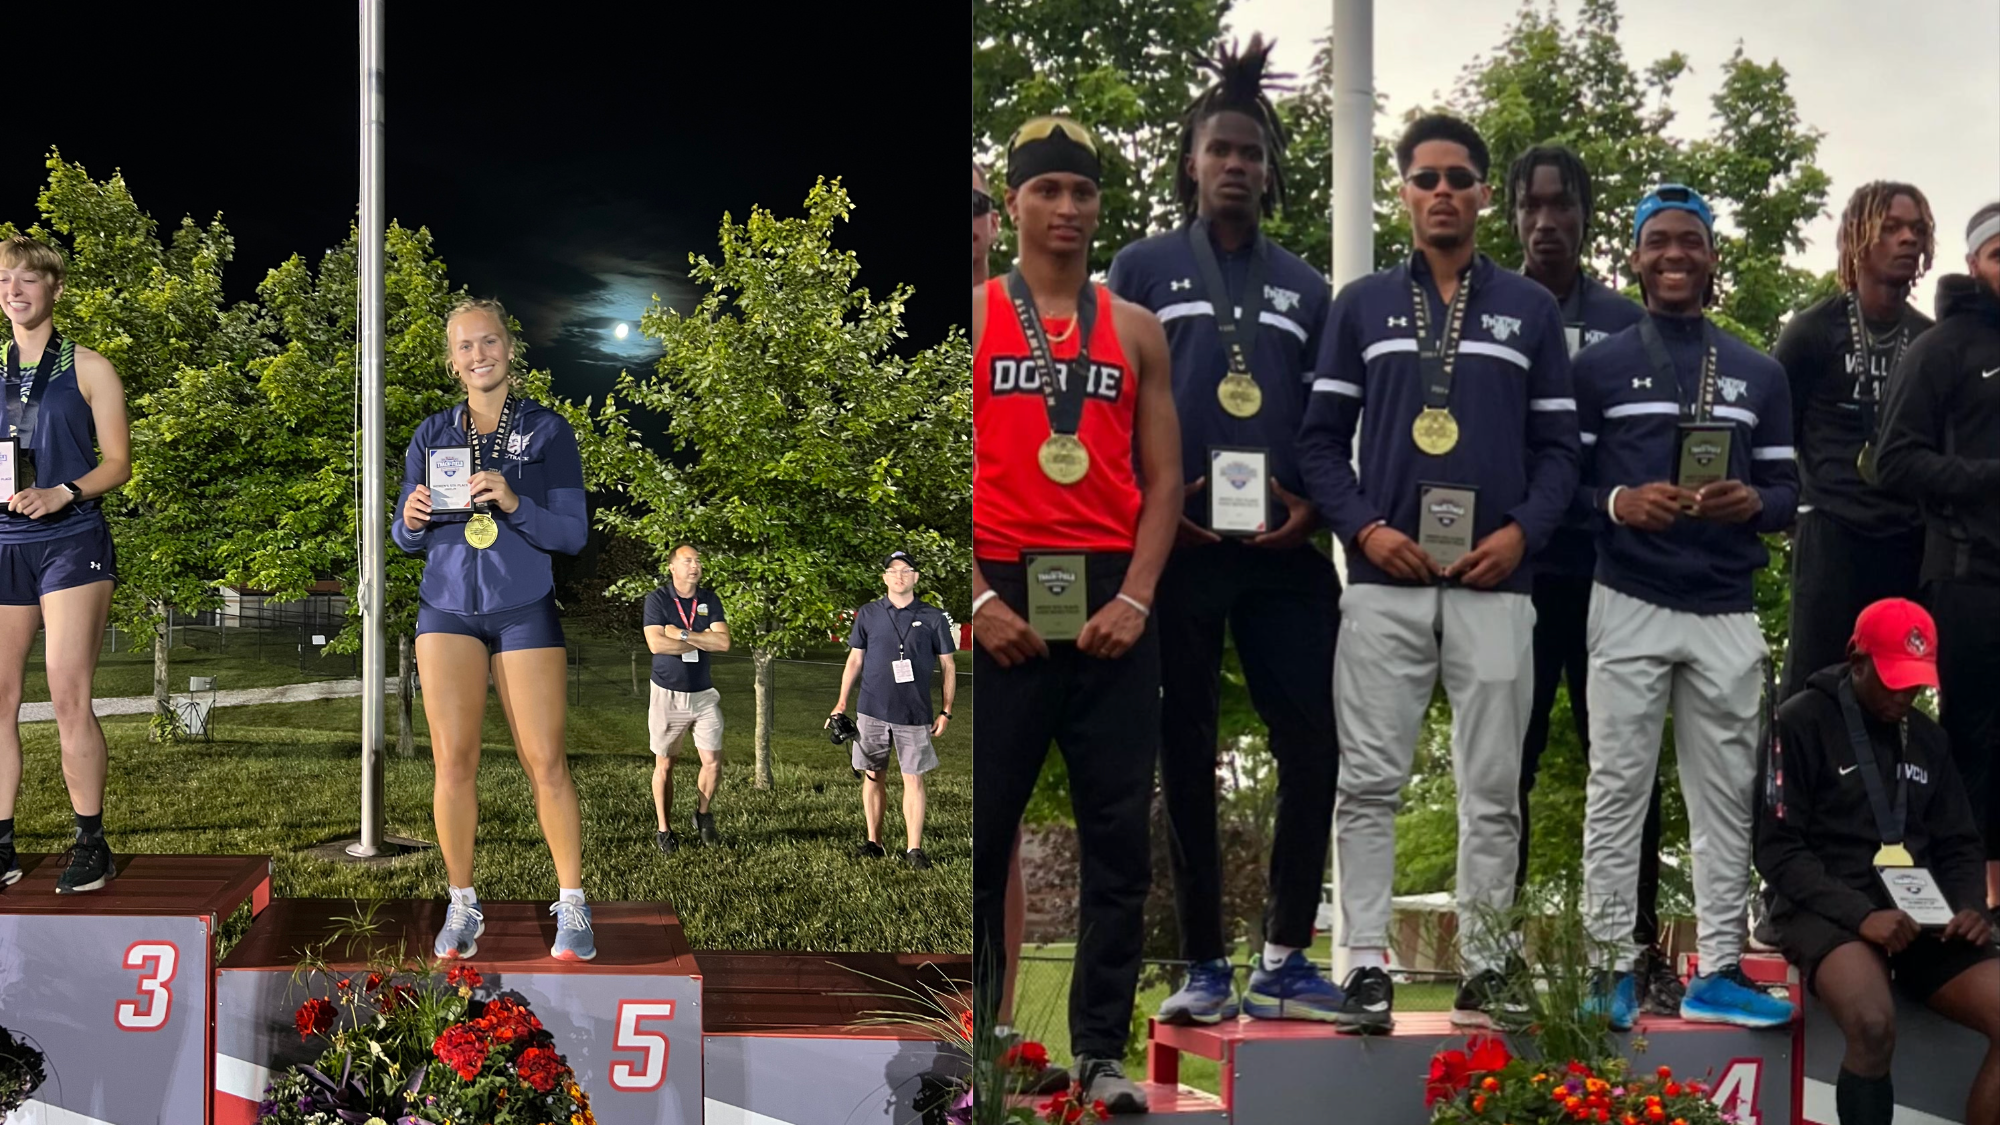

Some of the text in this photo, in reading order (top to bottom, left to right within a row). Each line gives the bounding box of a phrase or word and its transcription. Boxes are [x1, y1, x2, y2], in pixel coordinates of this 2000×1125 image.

[114, 940, 180, 1031] 3
[608, 998, 676, 1093] 5
[1707, 1057, 1763, 1125] 4
